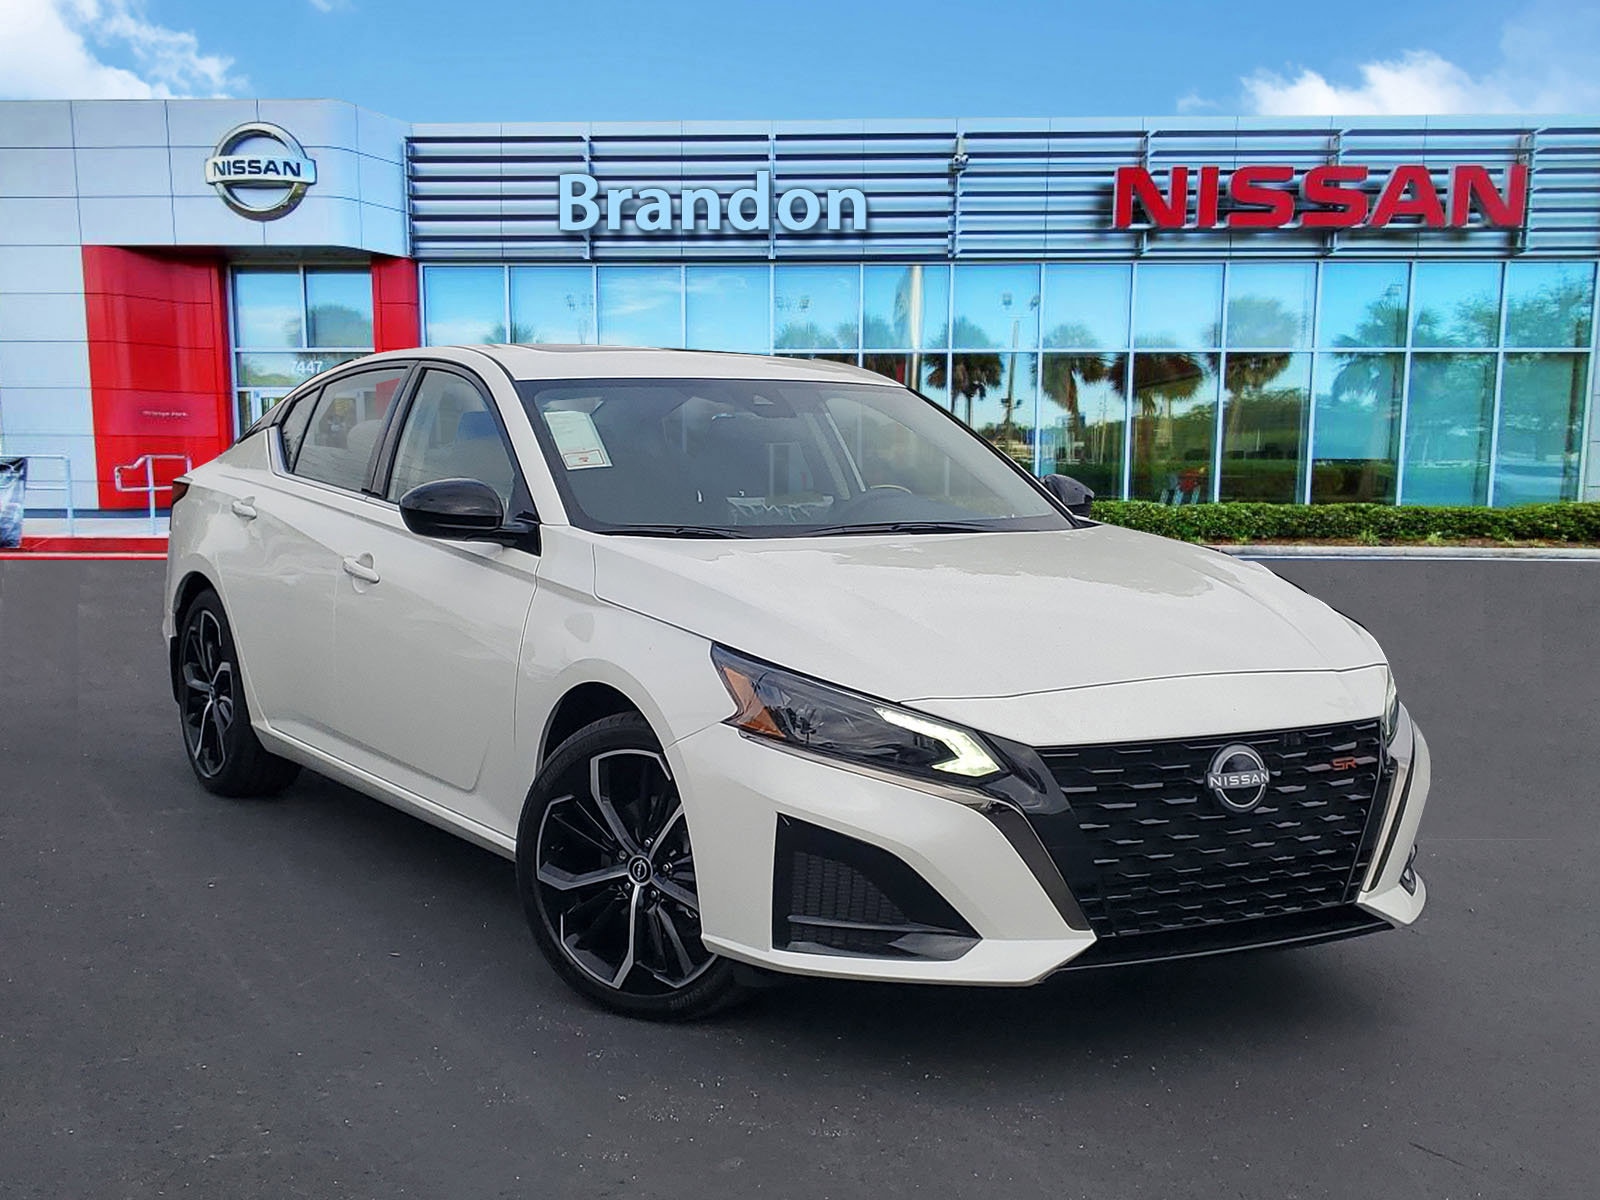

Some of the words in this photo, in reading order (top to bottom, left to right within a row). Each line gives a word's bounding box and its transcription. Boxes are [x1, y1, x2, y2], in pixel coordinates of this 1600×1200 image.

[213, 159, 301, 177] NISSAN
[558, 170, 867, 231] Brandon
[1112, 165, 1528, 228] NISSAN
[1332, 756, 1357, 770] SR
[1210, 768, 1269, 787] NISSAN
